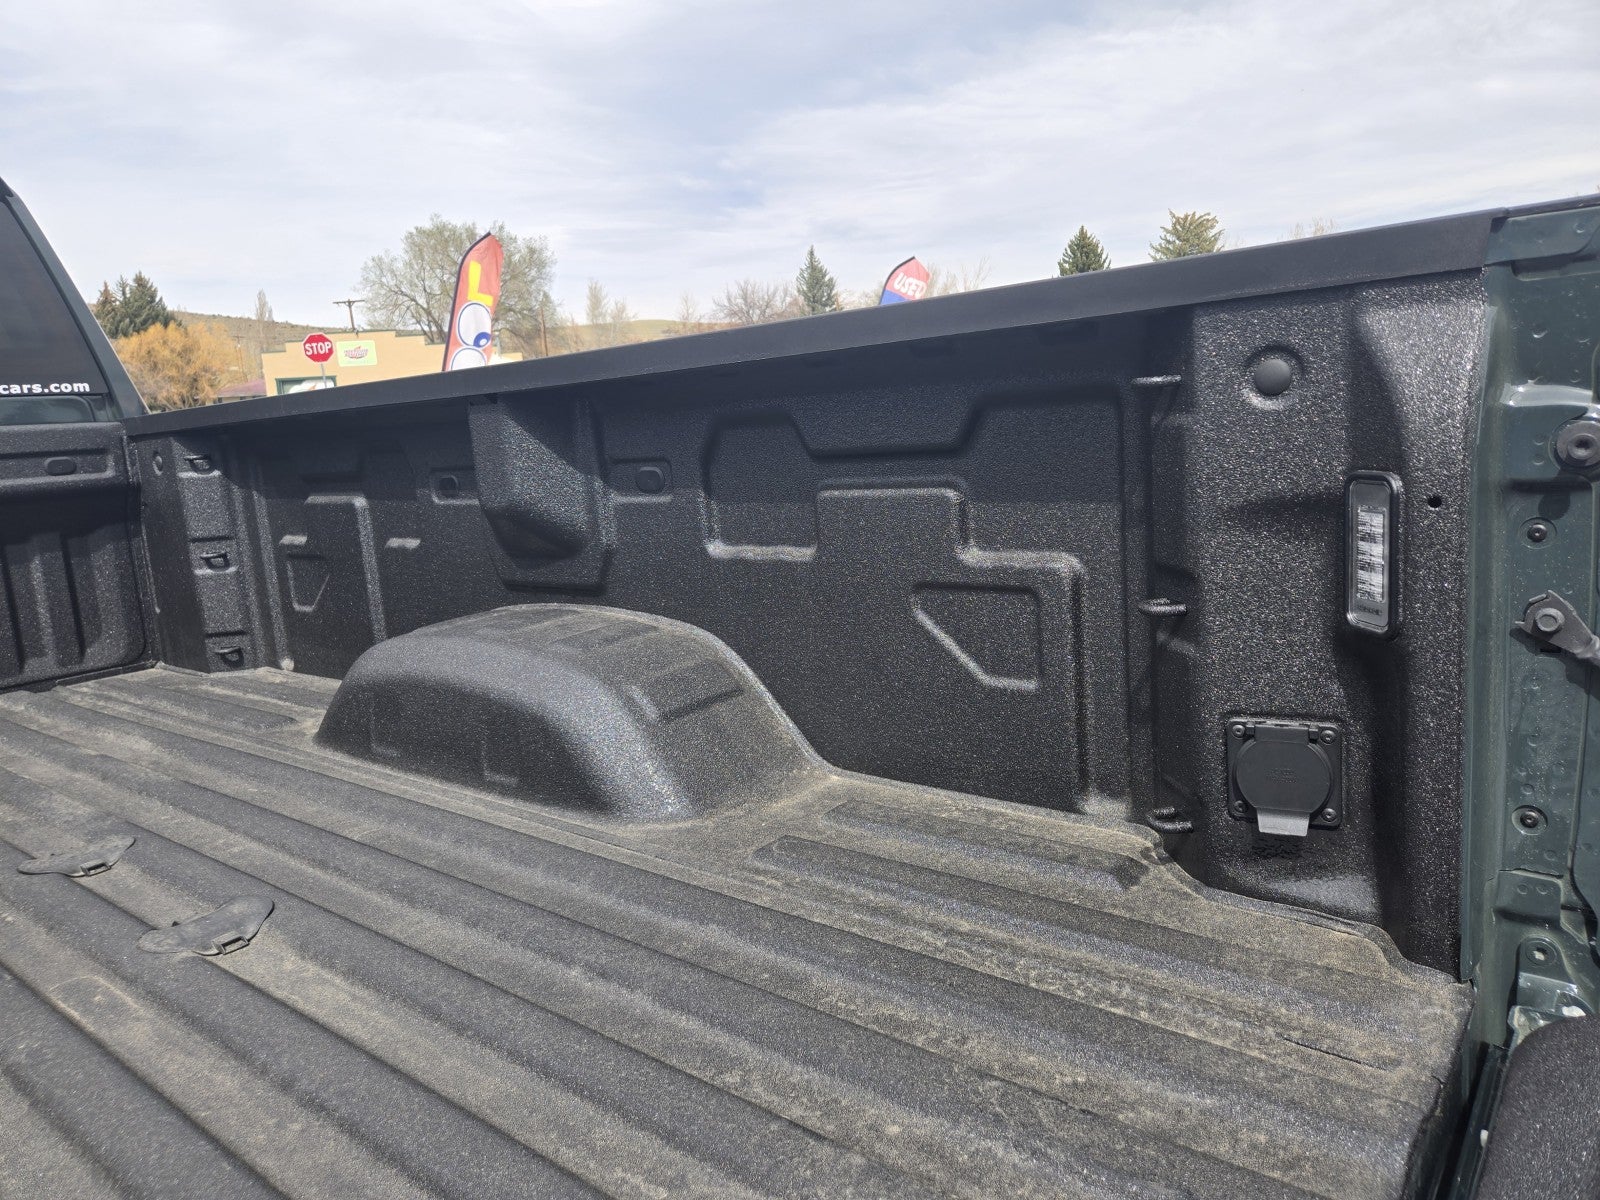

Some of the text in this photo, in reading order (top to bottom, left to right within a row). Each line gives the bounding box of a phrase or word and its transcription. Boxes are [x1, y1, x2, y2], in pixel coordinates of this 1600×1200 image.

[893, 271, 928, 300] USED
[304, 341, 332, 356] STOP
[0, 382, 90, 395] cars.com
